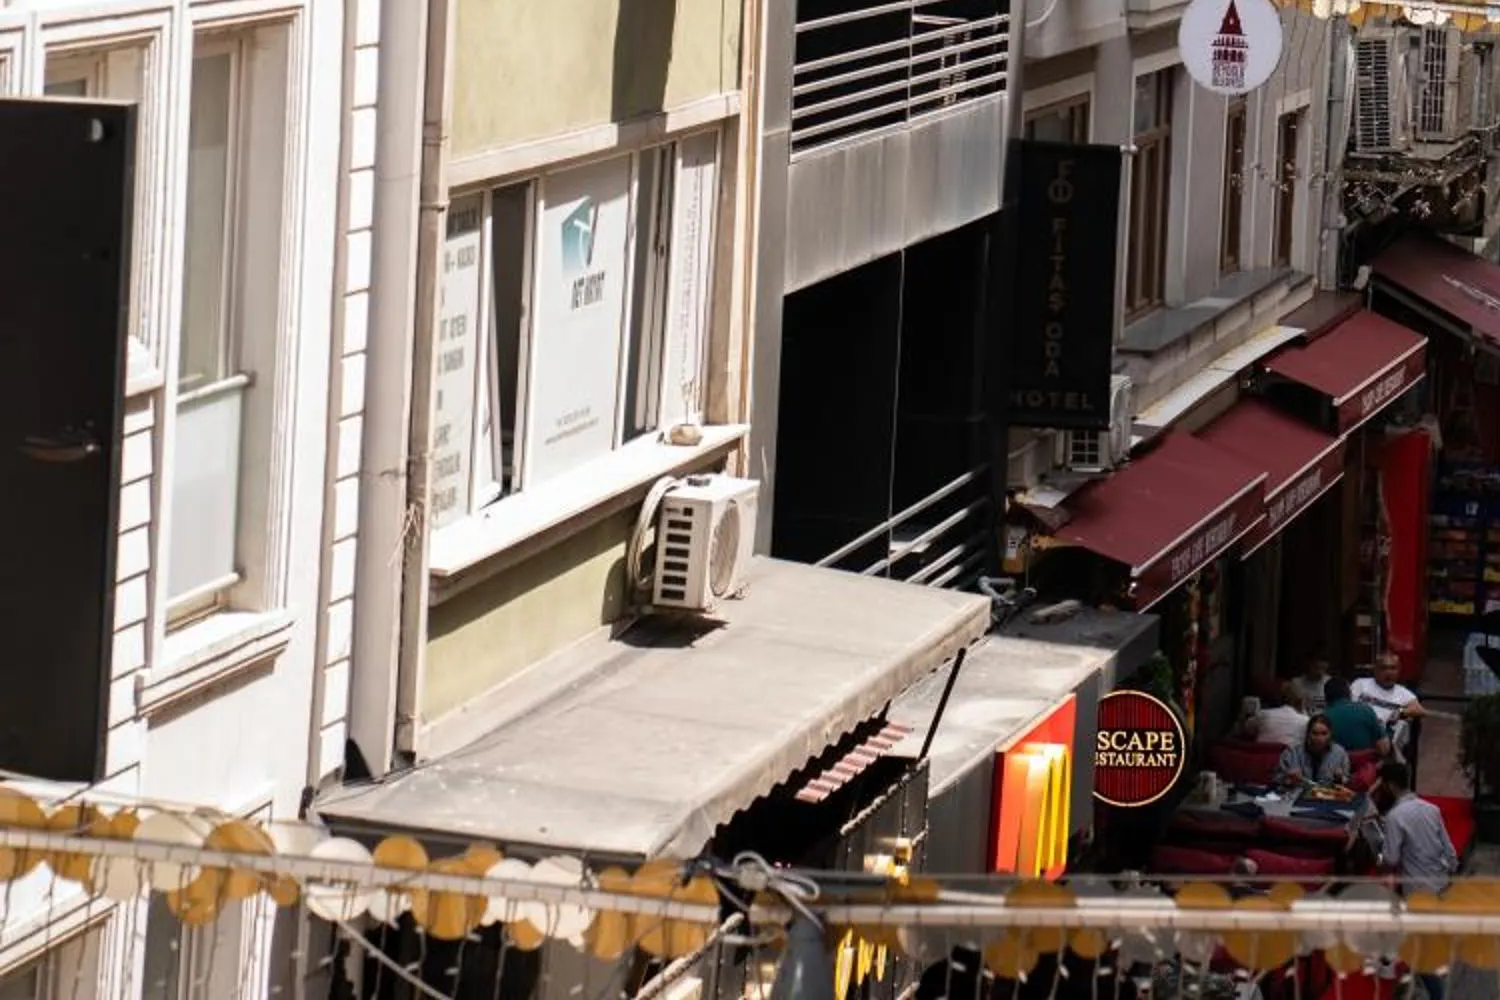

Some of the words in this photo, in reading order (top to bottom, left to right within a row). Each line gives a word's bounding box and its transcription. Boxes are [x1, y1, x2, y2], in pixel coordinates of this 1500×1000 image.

[1011, 390, 1094, 410] HOTEL
[1097, 730, 1175, 751] SCAPE
[1095, 752, 1176, 767] STAURANT
